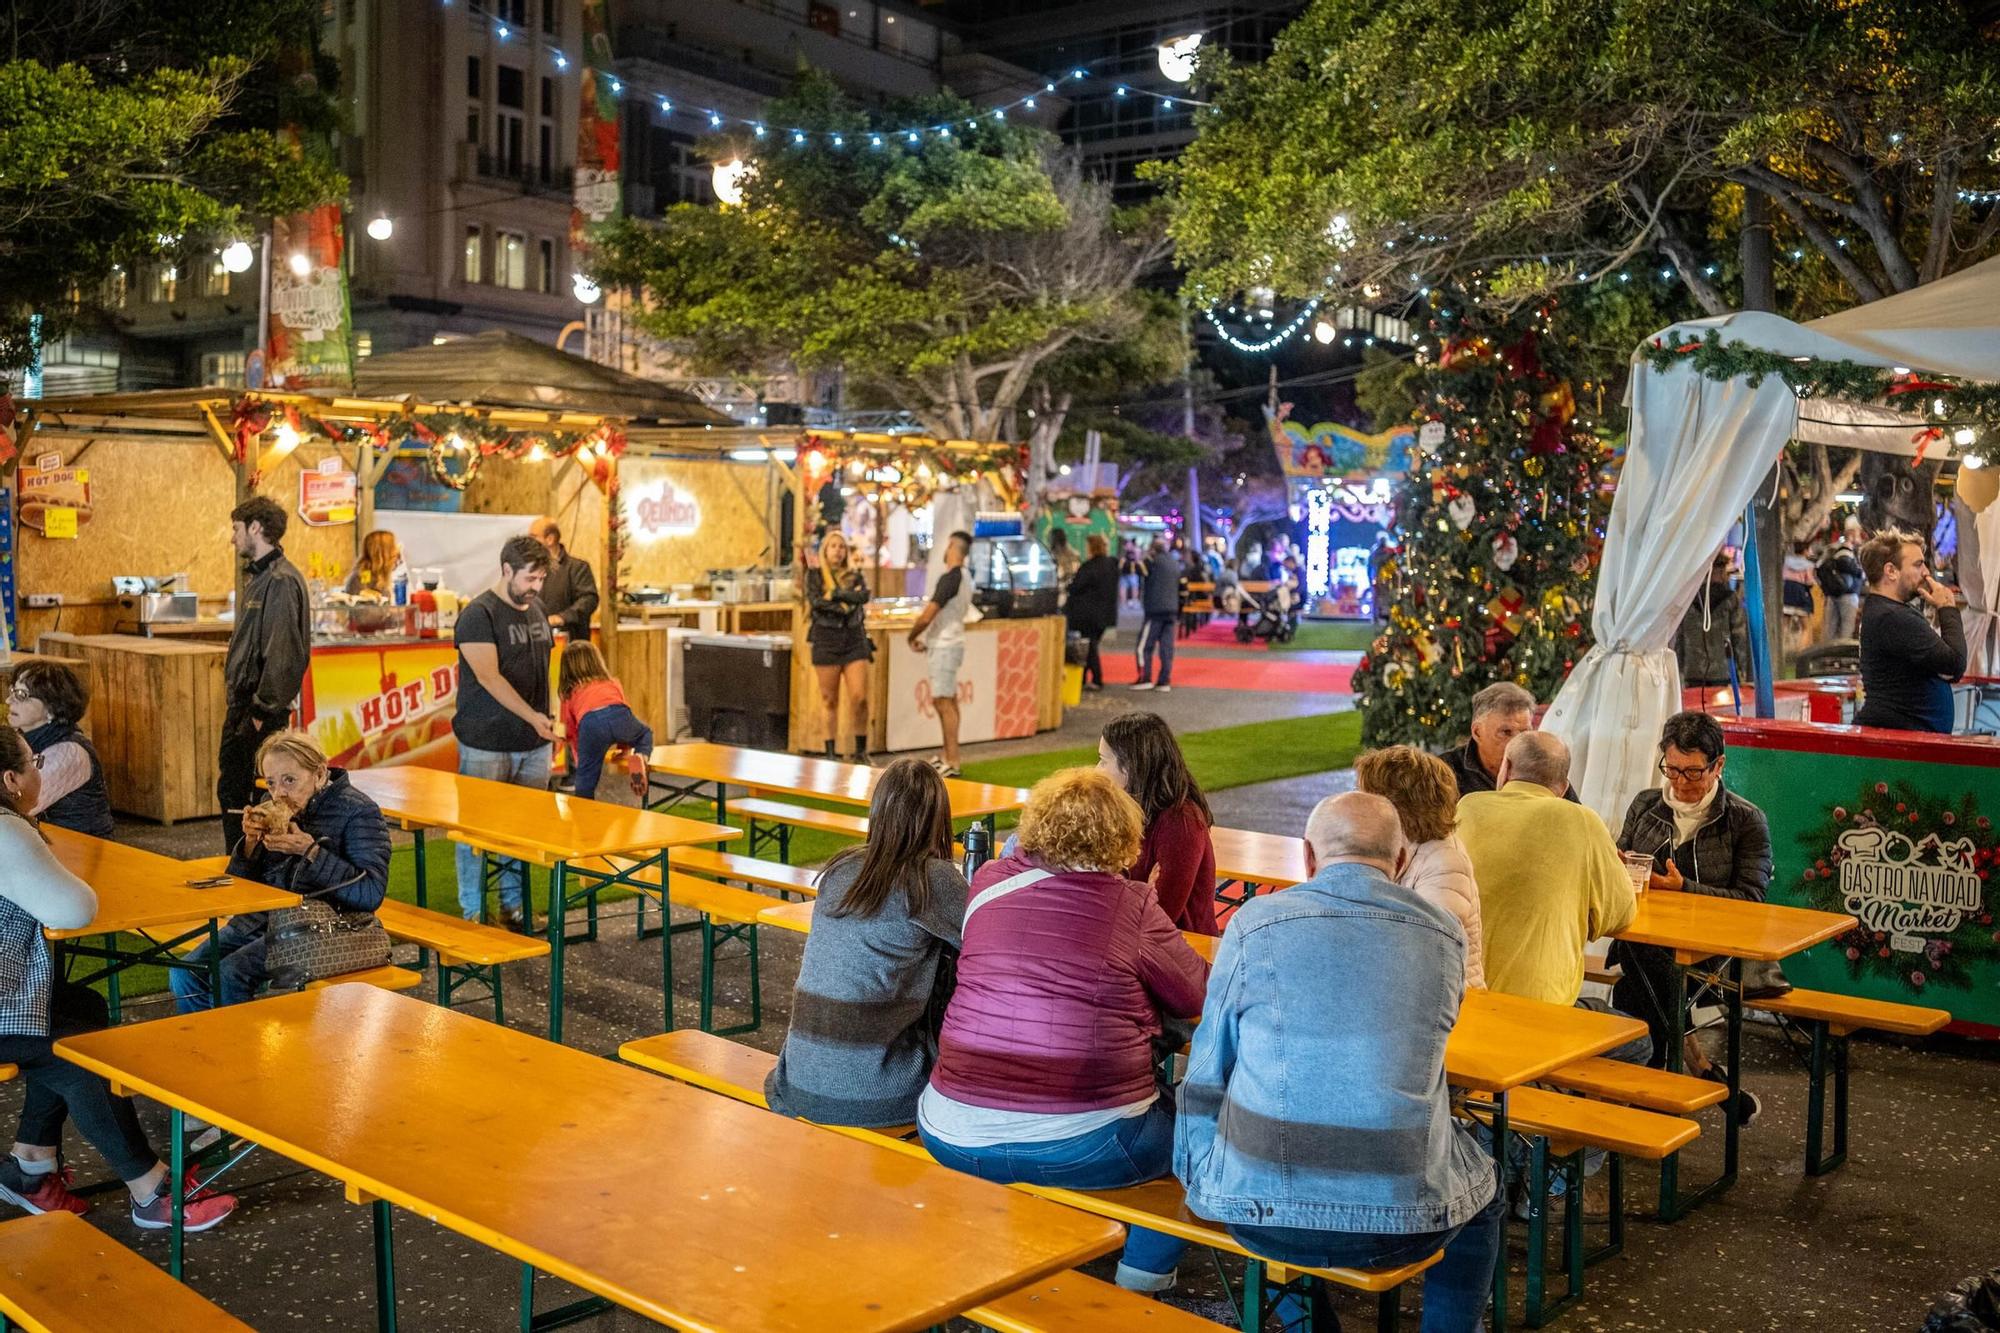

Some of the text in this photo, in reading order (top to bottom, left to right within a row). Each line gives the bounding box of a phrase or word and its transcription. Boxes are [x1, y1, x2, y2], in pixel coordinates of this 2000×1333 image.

[27, 471, 74, 487] HOT DOG
[360, 680, 422, 734] HOT
[1843, 861, 1978, 908] GASTRO NAVIDAD
[1863, 899, 1957, 932] Market
[1892, 937, 1925, 949] FEST
